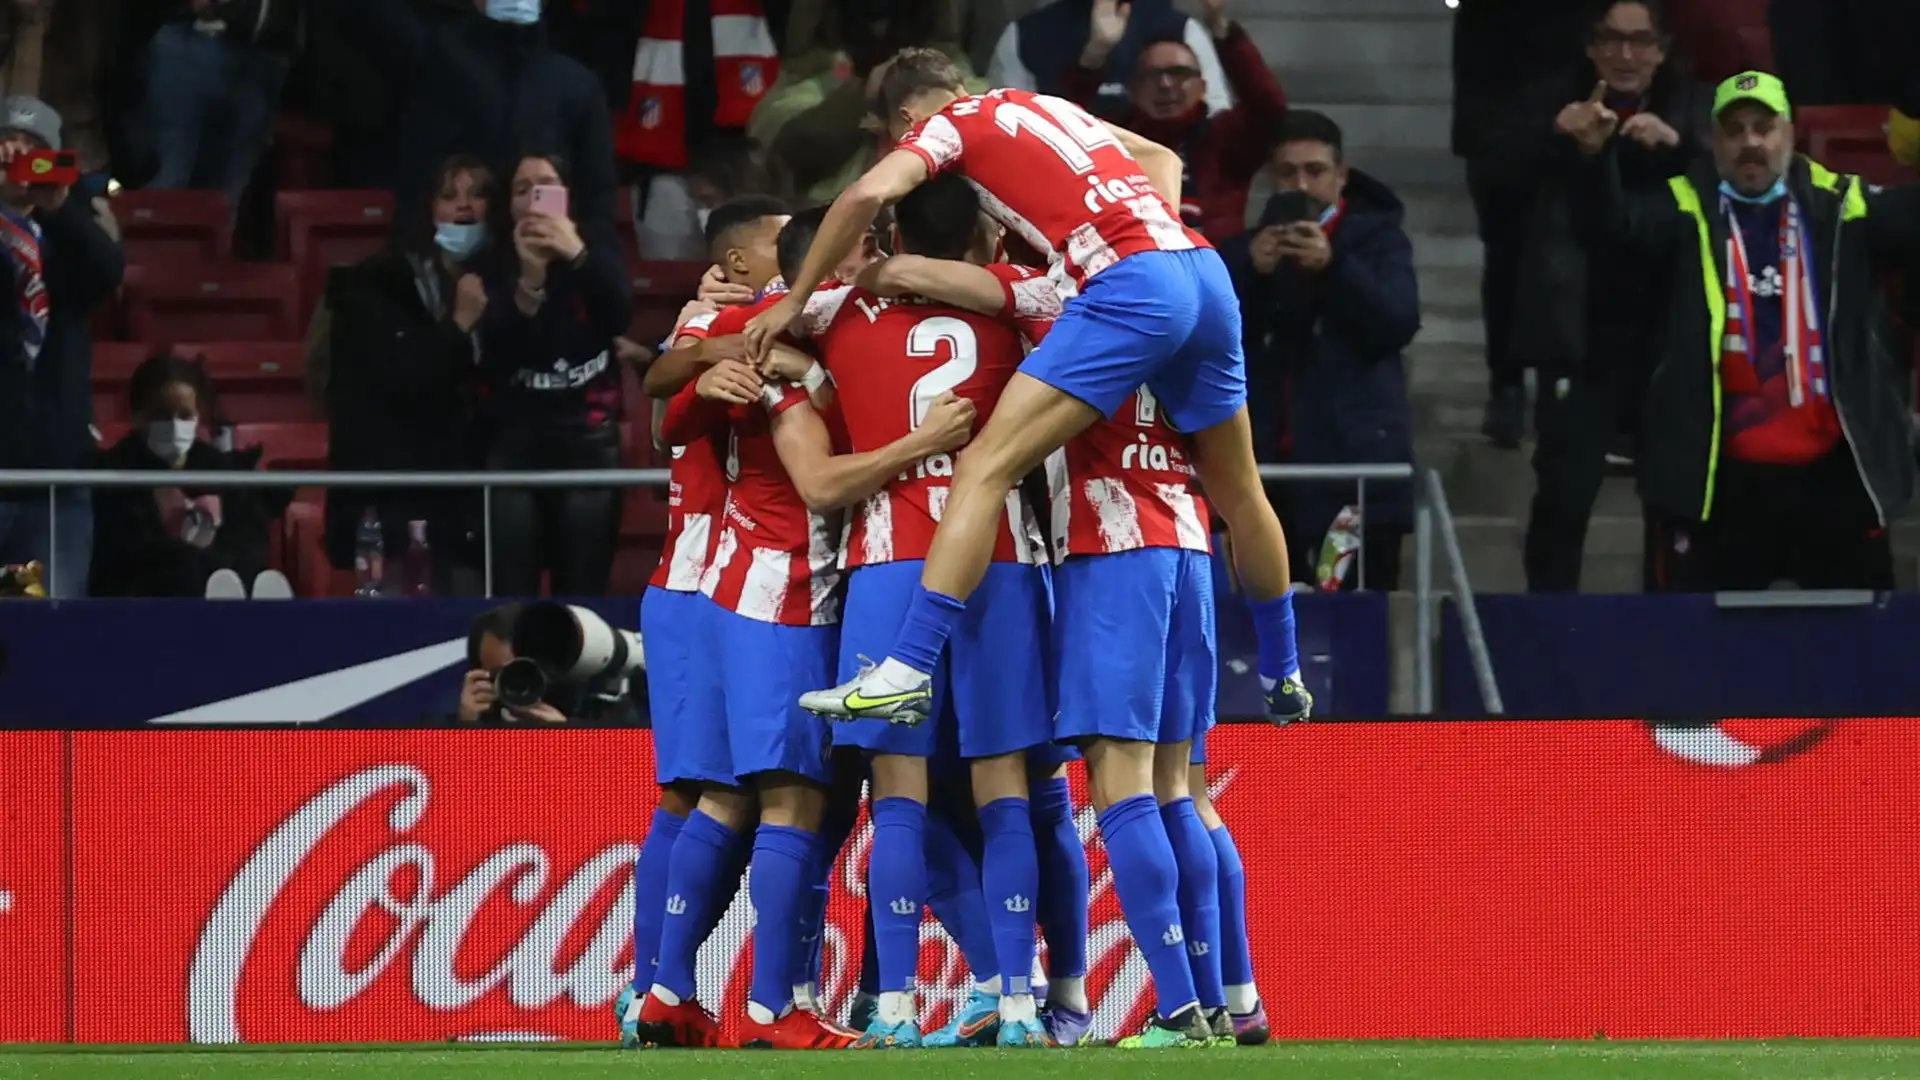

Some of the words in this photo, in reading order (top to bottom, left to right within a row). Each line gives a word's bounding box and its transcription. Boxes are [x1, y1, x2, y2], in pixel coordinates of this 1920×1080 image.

[994, 93, 1135, 175] 14
[1084, 174, 1138, 214] ria
[906, 316, 977, 433] 2
[898, 452, 953, 481] ia
[1121, 432, 1170, 471] ria
